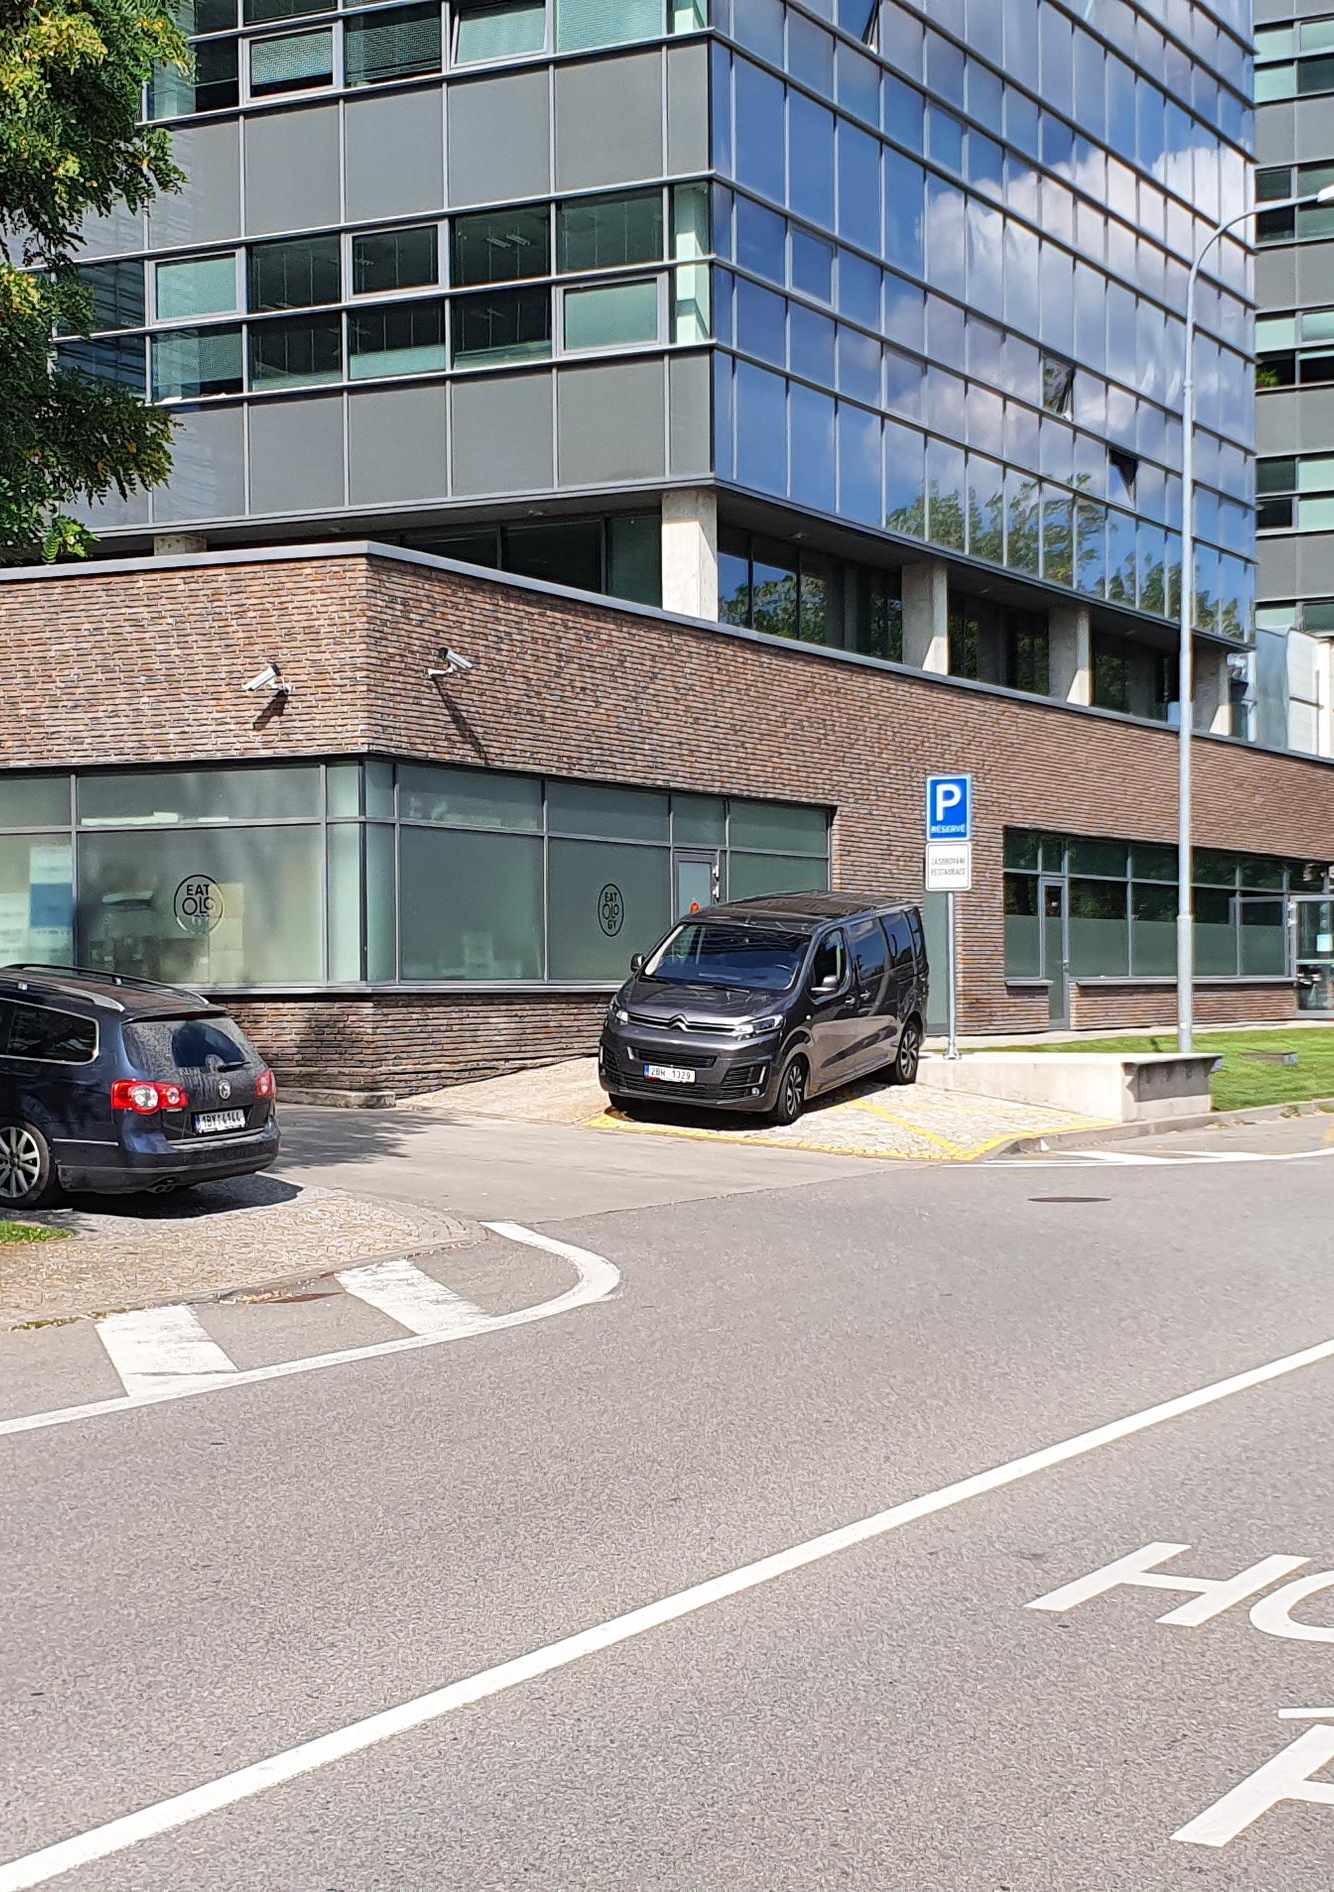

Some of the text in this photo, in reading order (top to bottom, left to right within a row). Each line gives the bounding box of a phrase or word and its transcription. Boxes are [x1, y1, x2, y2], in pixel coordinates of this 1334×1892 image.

[936, 784, 961, 821] P
[187, 884, 210, 896] EAT
[605, 892, 617, 902] EAT
